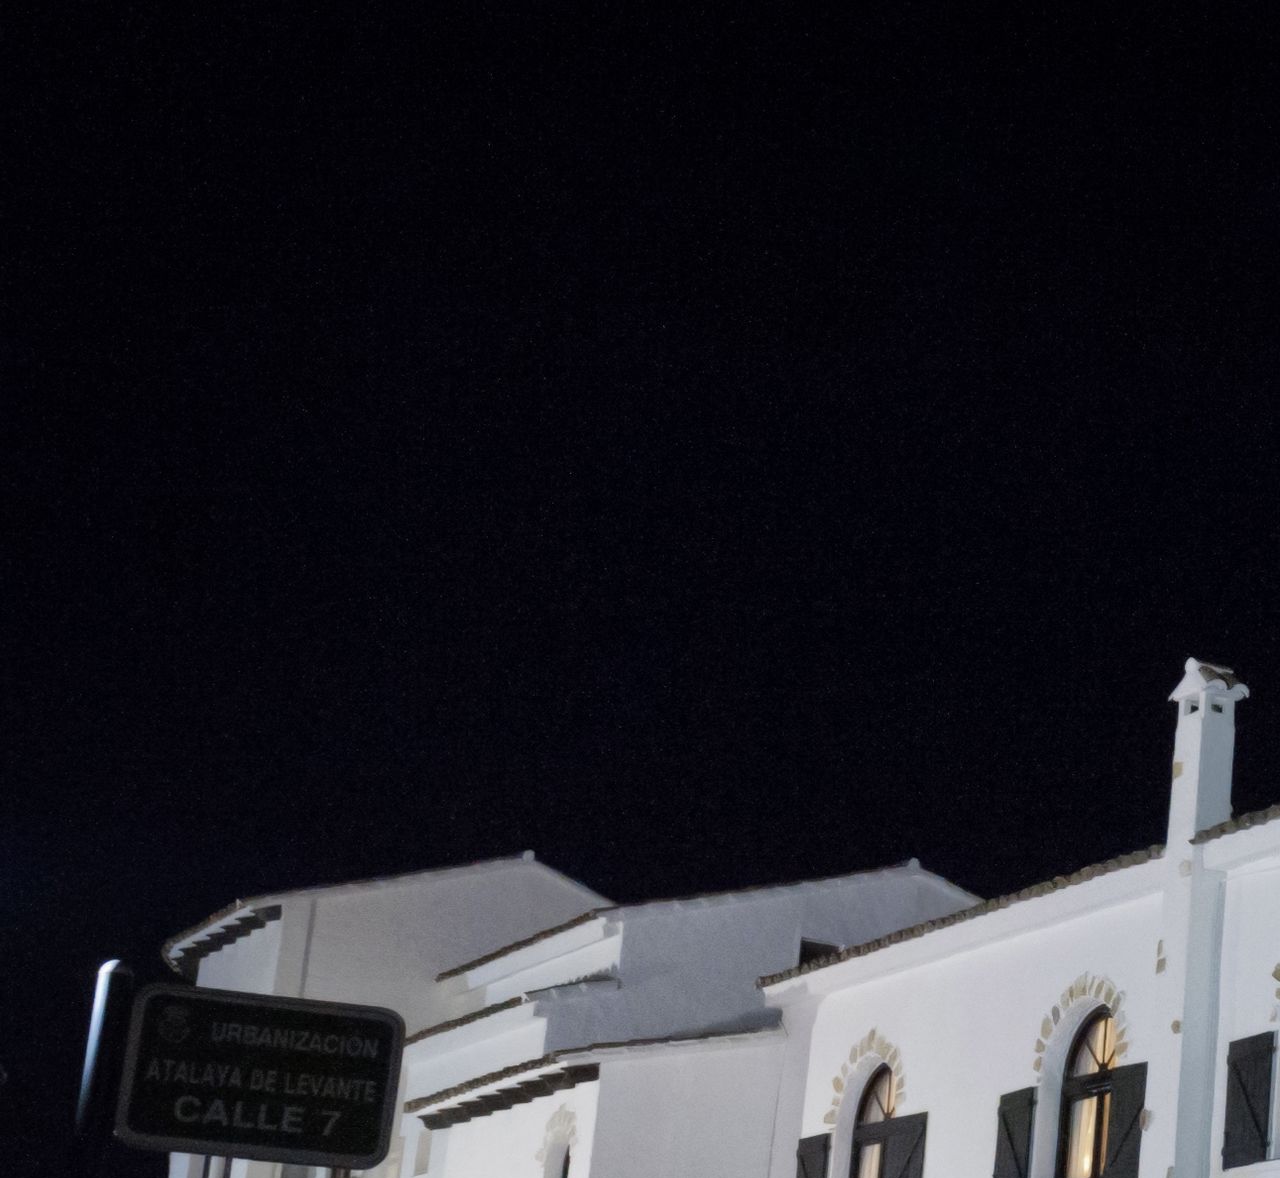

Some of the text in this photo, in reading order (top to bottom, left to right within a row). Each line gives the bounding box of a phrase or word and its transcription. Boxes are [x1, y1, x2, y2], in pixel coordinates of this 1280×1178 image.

[144, 1058, 378, 1103] ATALAYA DE LEVANTE
[173, 1094, 342, 1137] CALLE 7
